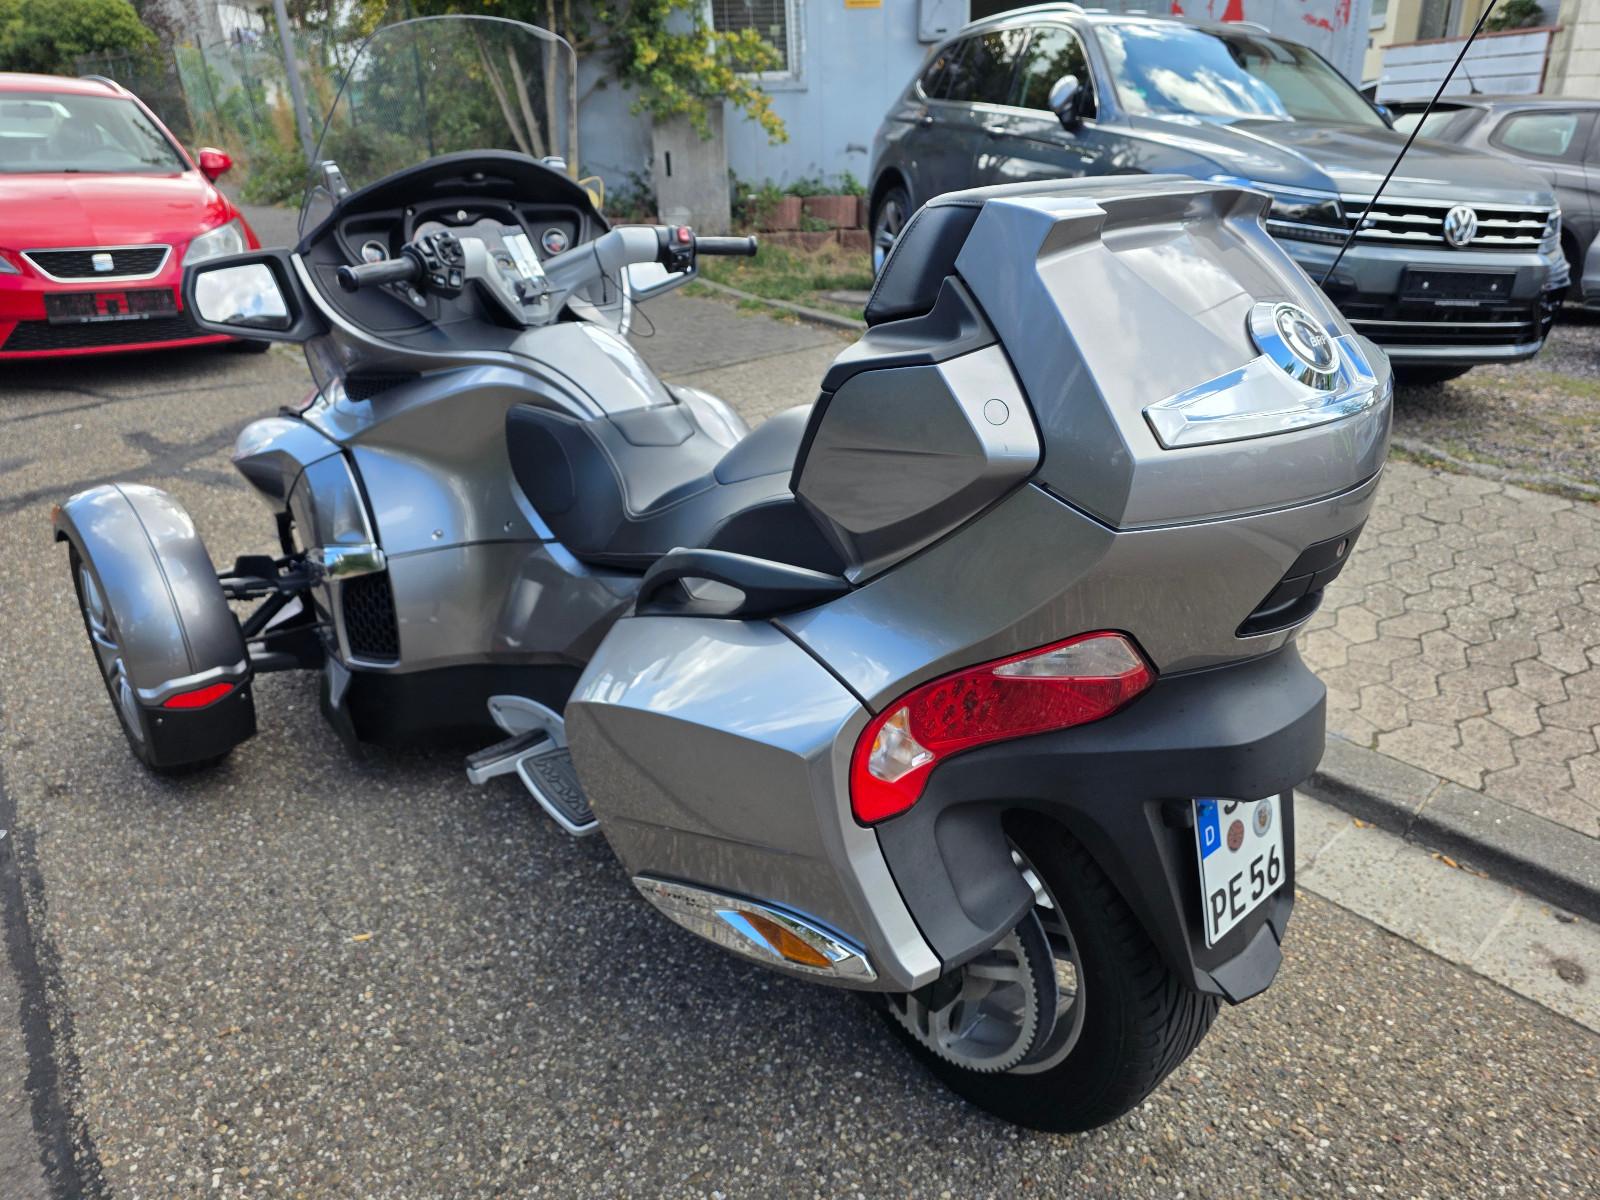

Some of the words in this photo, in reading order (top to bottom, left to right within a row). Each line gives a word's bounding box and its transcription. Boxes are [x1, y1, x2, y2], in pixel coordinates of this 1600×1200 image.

[1445, 205, 1477, 245] VW
[1205, 825, 1215, 846] D
[1210, 871, 1246, 935] PE
[1250, 844, 1280, 901] 56
